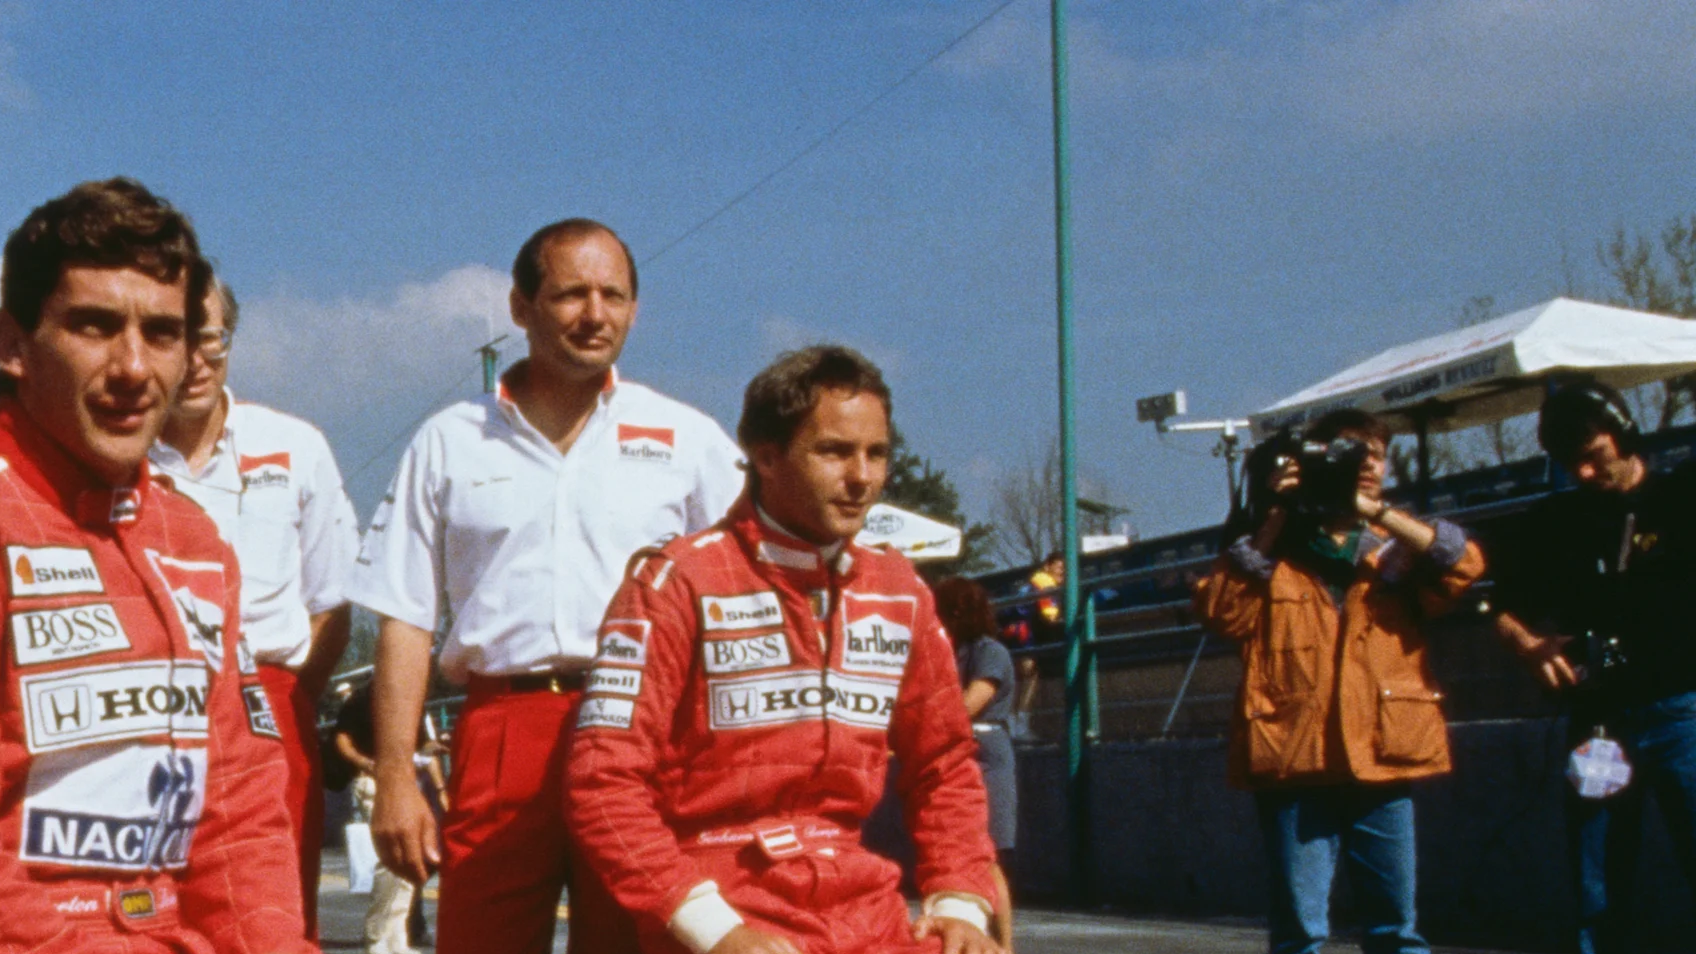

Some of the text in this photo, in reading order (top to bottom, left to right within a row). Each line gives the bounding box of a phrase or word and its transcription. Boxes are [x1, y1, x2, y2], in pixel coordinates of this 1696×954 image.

[35, 567, 95, 582] Shell
[726, 606, 778, 621] Shell
[24, 608, 117, 649] BOSS
[712, 635, 783, 666] BOSS
